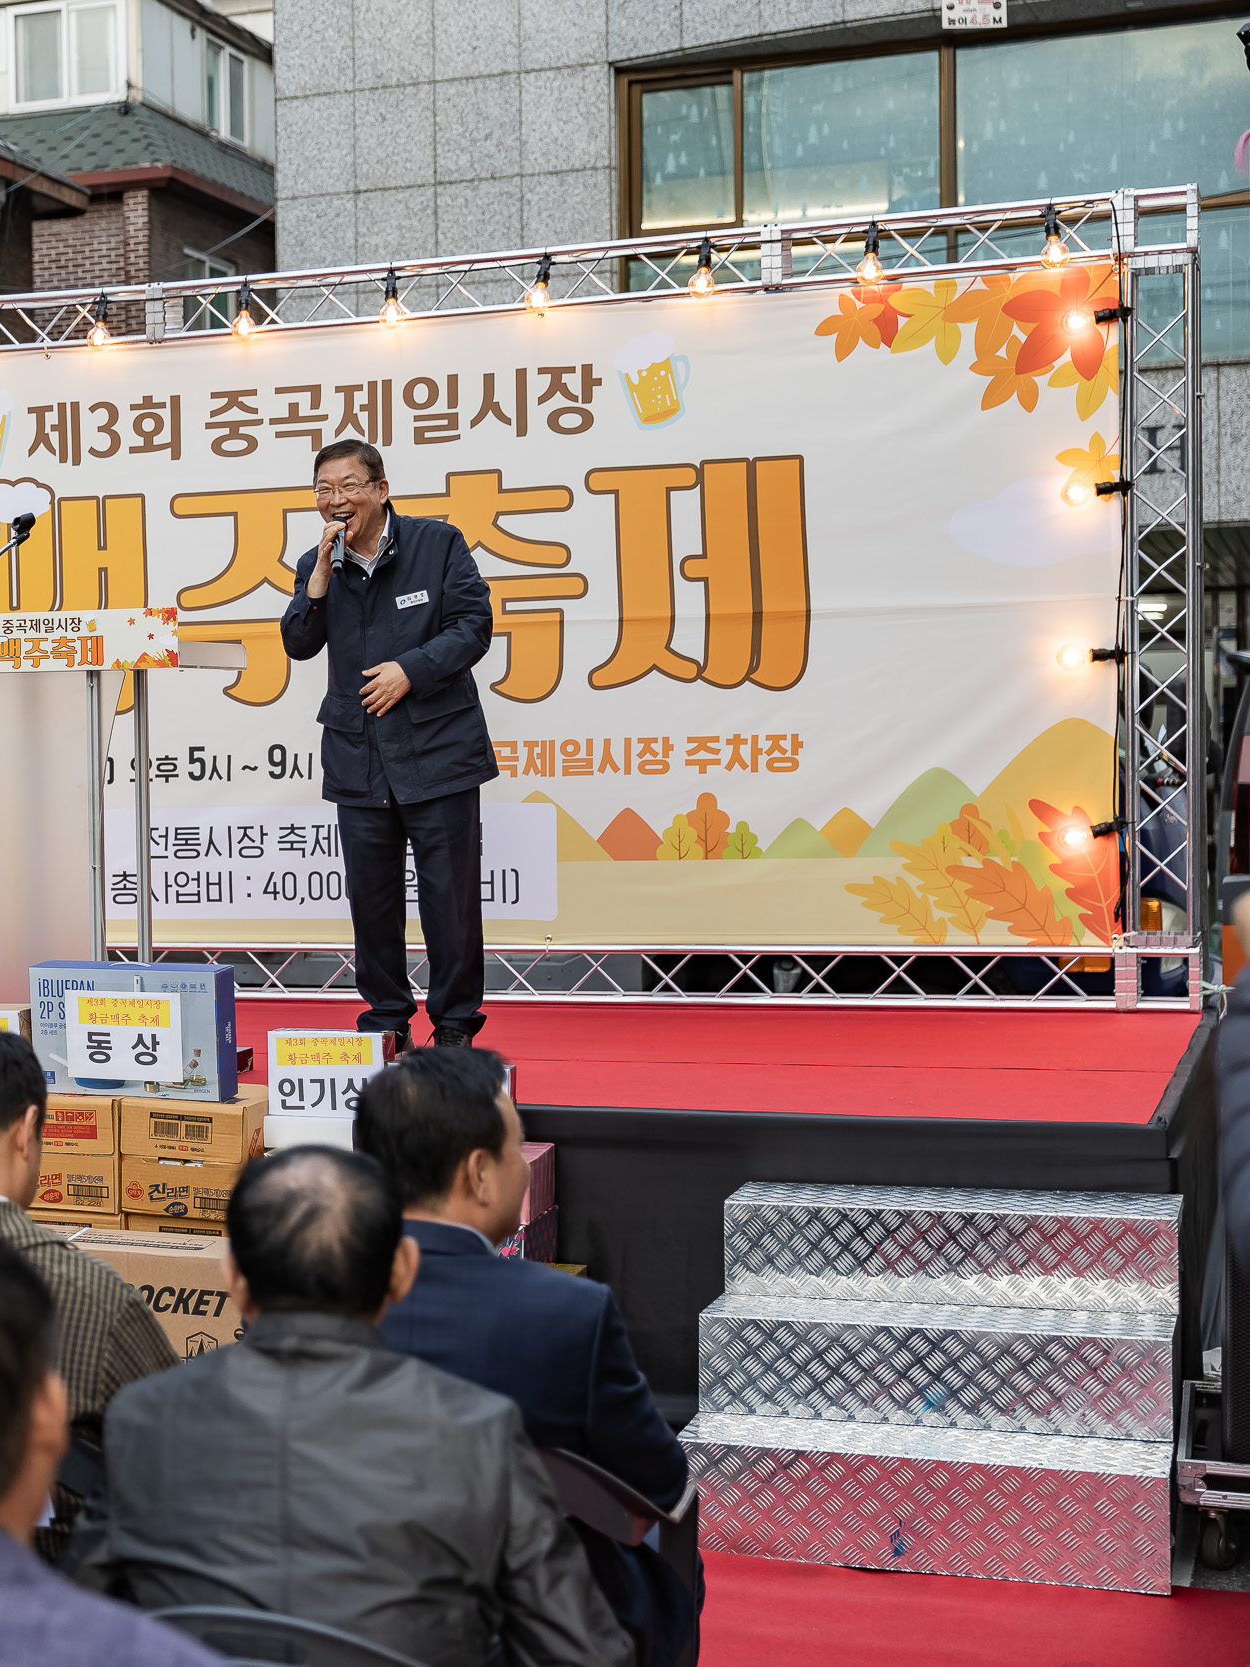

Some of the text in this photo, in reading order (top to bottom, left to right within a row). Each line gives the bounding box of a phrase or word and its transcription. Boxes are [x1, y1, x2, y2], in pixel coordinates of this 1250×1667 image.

[27, 363, 602, 467] 제3회 중곡제일시장
[2, 616, 82, 634] 중곡제일시장
[188, 746, 232, 782] 5시
[267, 743, 313, 781] 9시
[492, 733, 804, 778] 곡제일시장 주차장
[39, 1001, 54, 1020] 2P
[86, 997, 162, 1010] 제3회 중곡제일시장
[88, 1011, 160, 1027] 황금맥주 축제
[284, 1037, 364, 1047] 제3회 중곡제일시장
[287, 1051, 362, 1066] 황금맥주 축제
[39, 1172, 62, 1187] 라면
[148, 1182, 190, 1203] 진라면
[128, 1283, 231, 1318] OCKET
